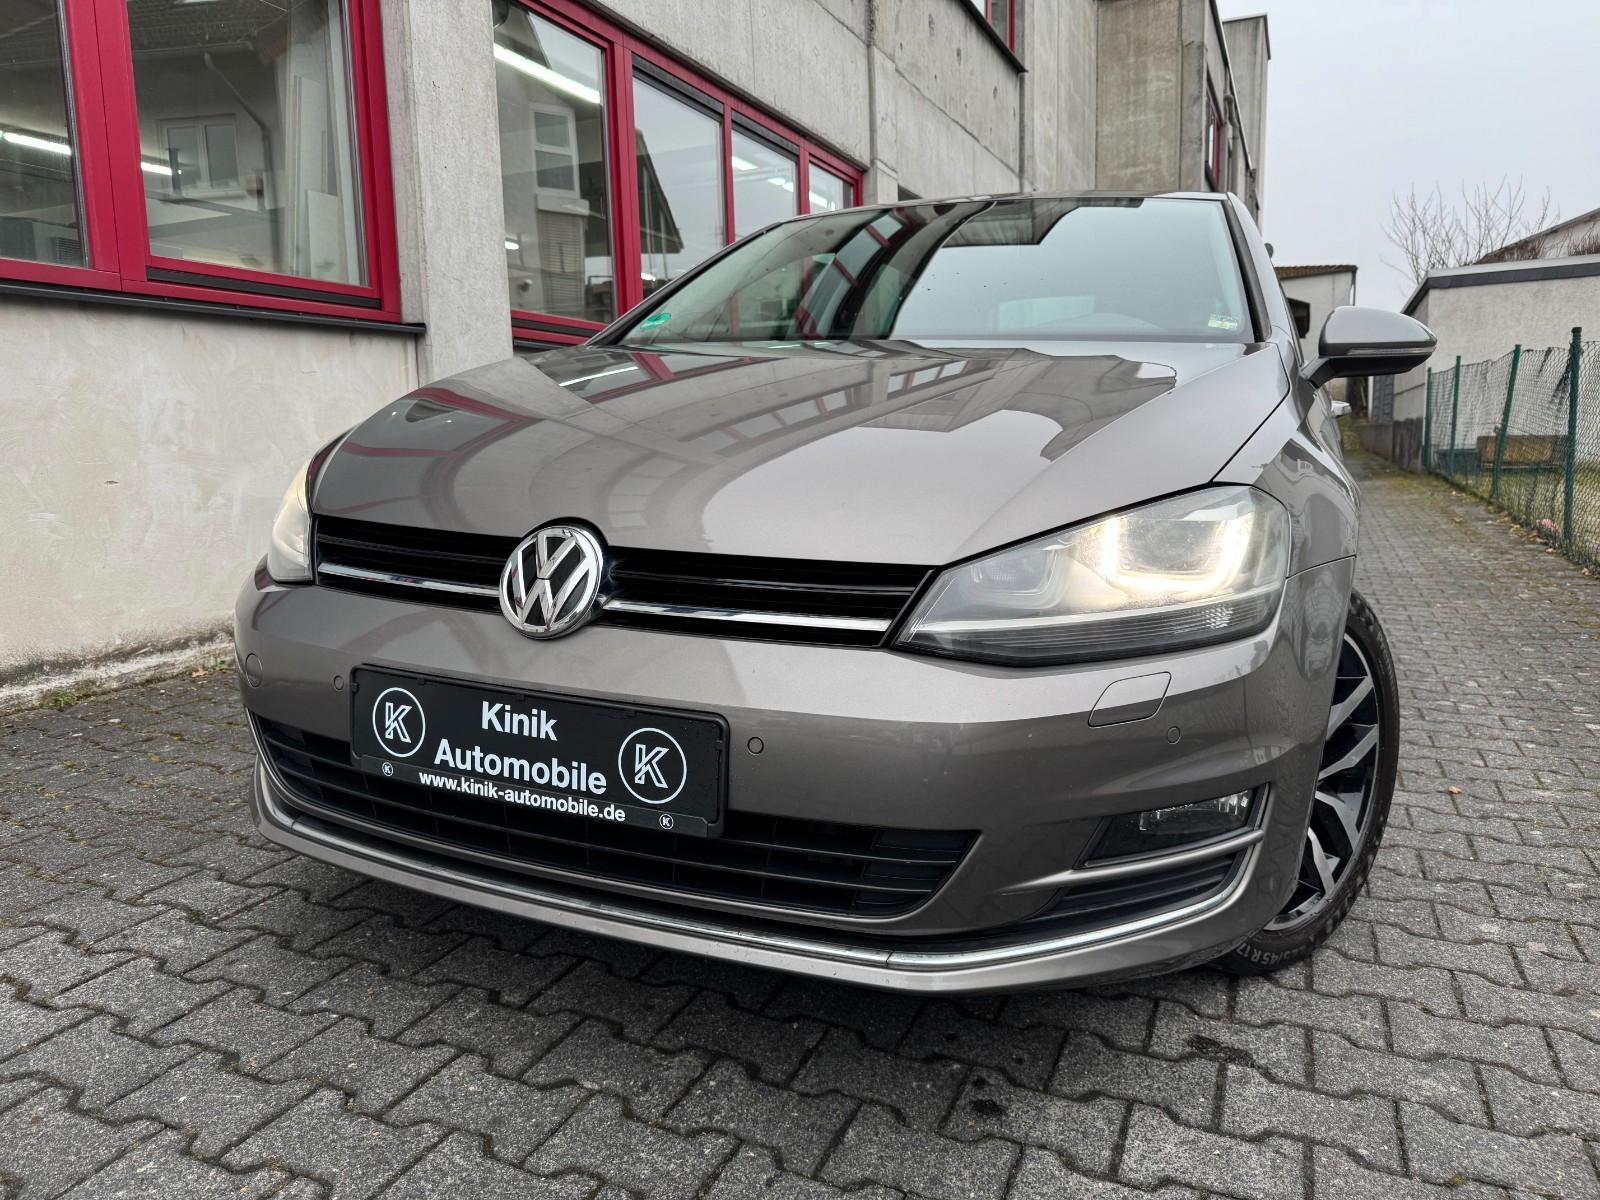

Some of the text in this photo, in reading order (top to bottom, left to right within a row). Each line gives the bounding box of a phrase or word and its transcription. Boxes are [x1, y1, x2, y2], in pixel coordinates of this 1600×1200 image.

[385, 702, 412, 743] K
[481, 701, 558, 742] Kinik
[434, 738, 607, 795] Automobile
[635, 744, 670, 788] K
[419, 771, 626, 822] www.kinik-automobile.de
